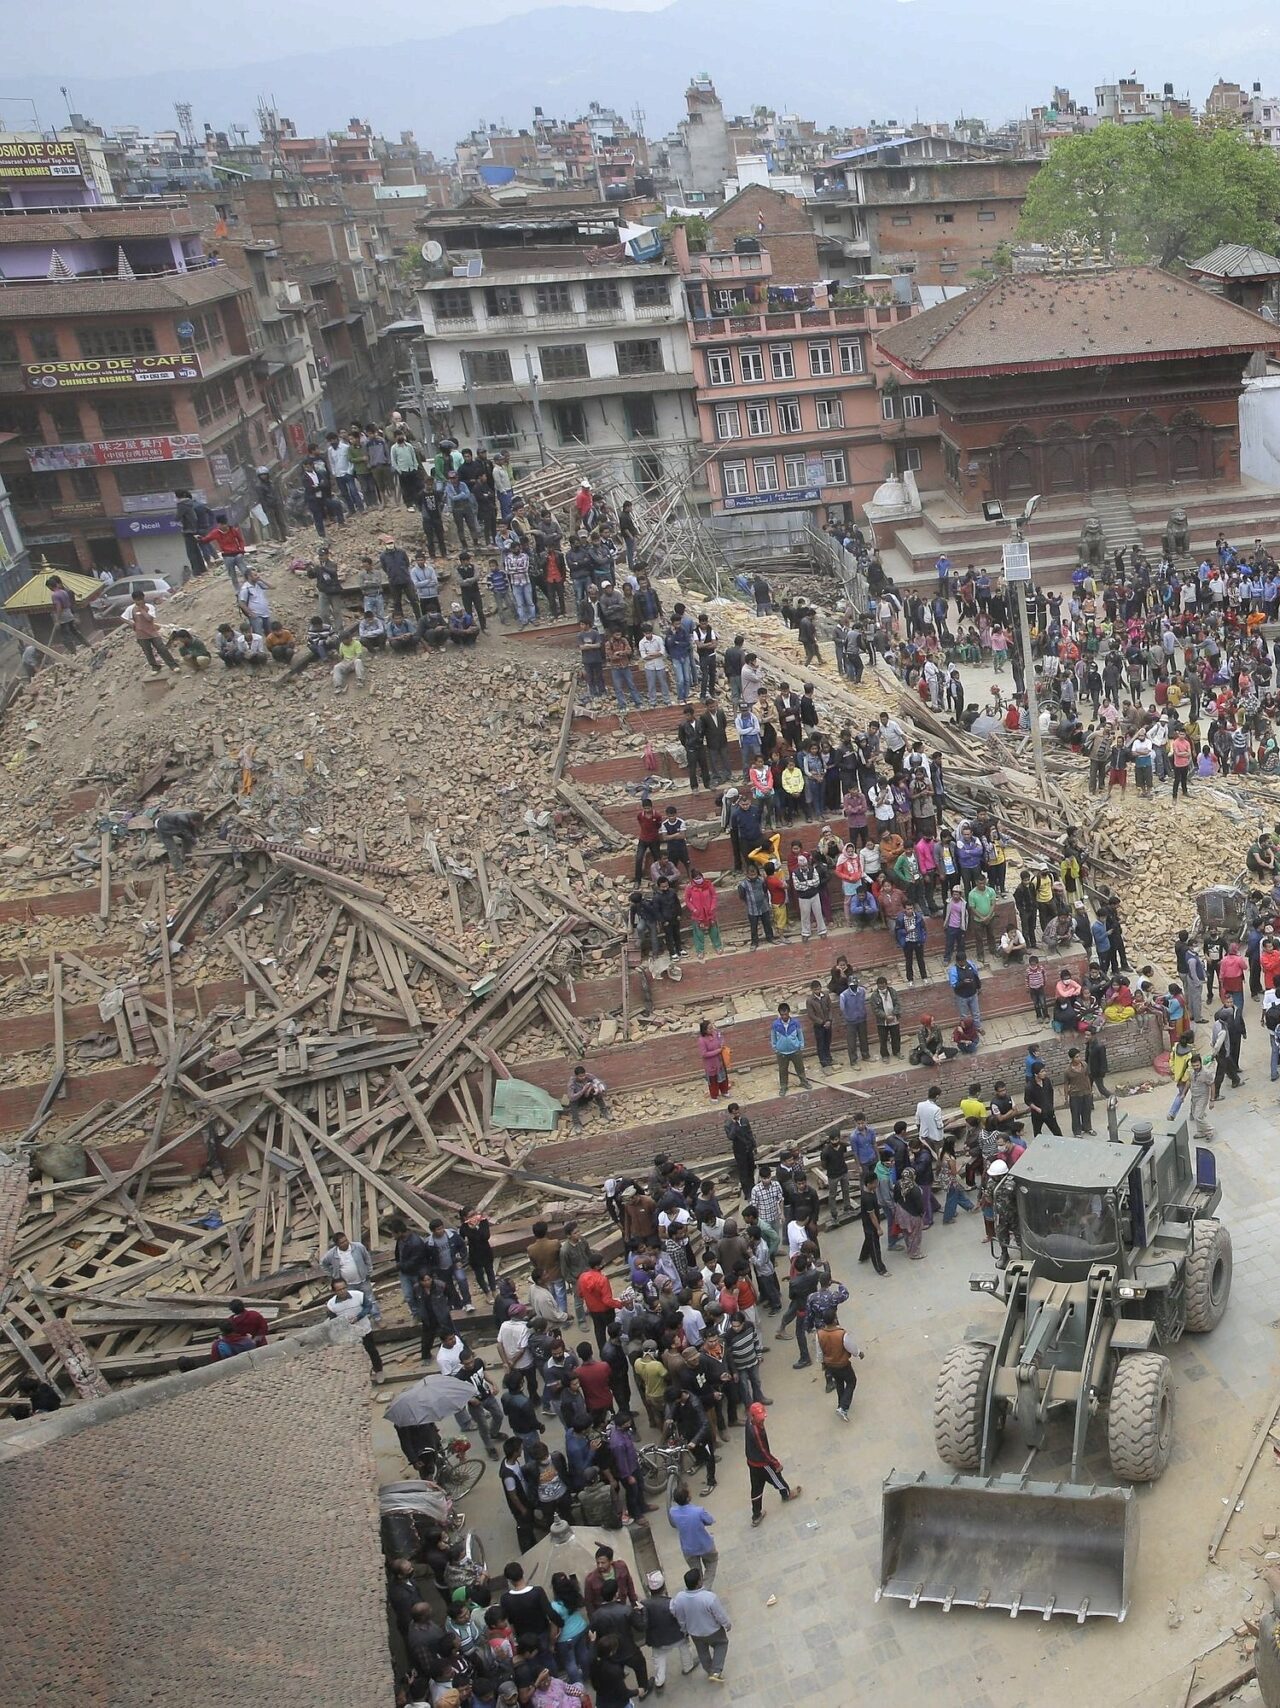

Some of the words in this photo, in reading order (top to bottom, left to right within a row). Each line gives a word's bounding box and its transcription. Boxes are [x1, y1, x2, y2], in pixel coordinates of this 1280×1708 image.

[27, 145, 44, 156] DE'
[47, 144, 75, 156] CAFE
[24, 166, 50, 176] DISHES
[27, 361, 101, 374] COSMO
[106, 359, 136, 369] DE'
[142, 355, 194, 367] CAFE
[59, 377, 99, 386] CHINESE
[100, 375, 133, 383] DISHES
[141, 521, 161, 530] Ncell
